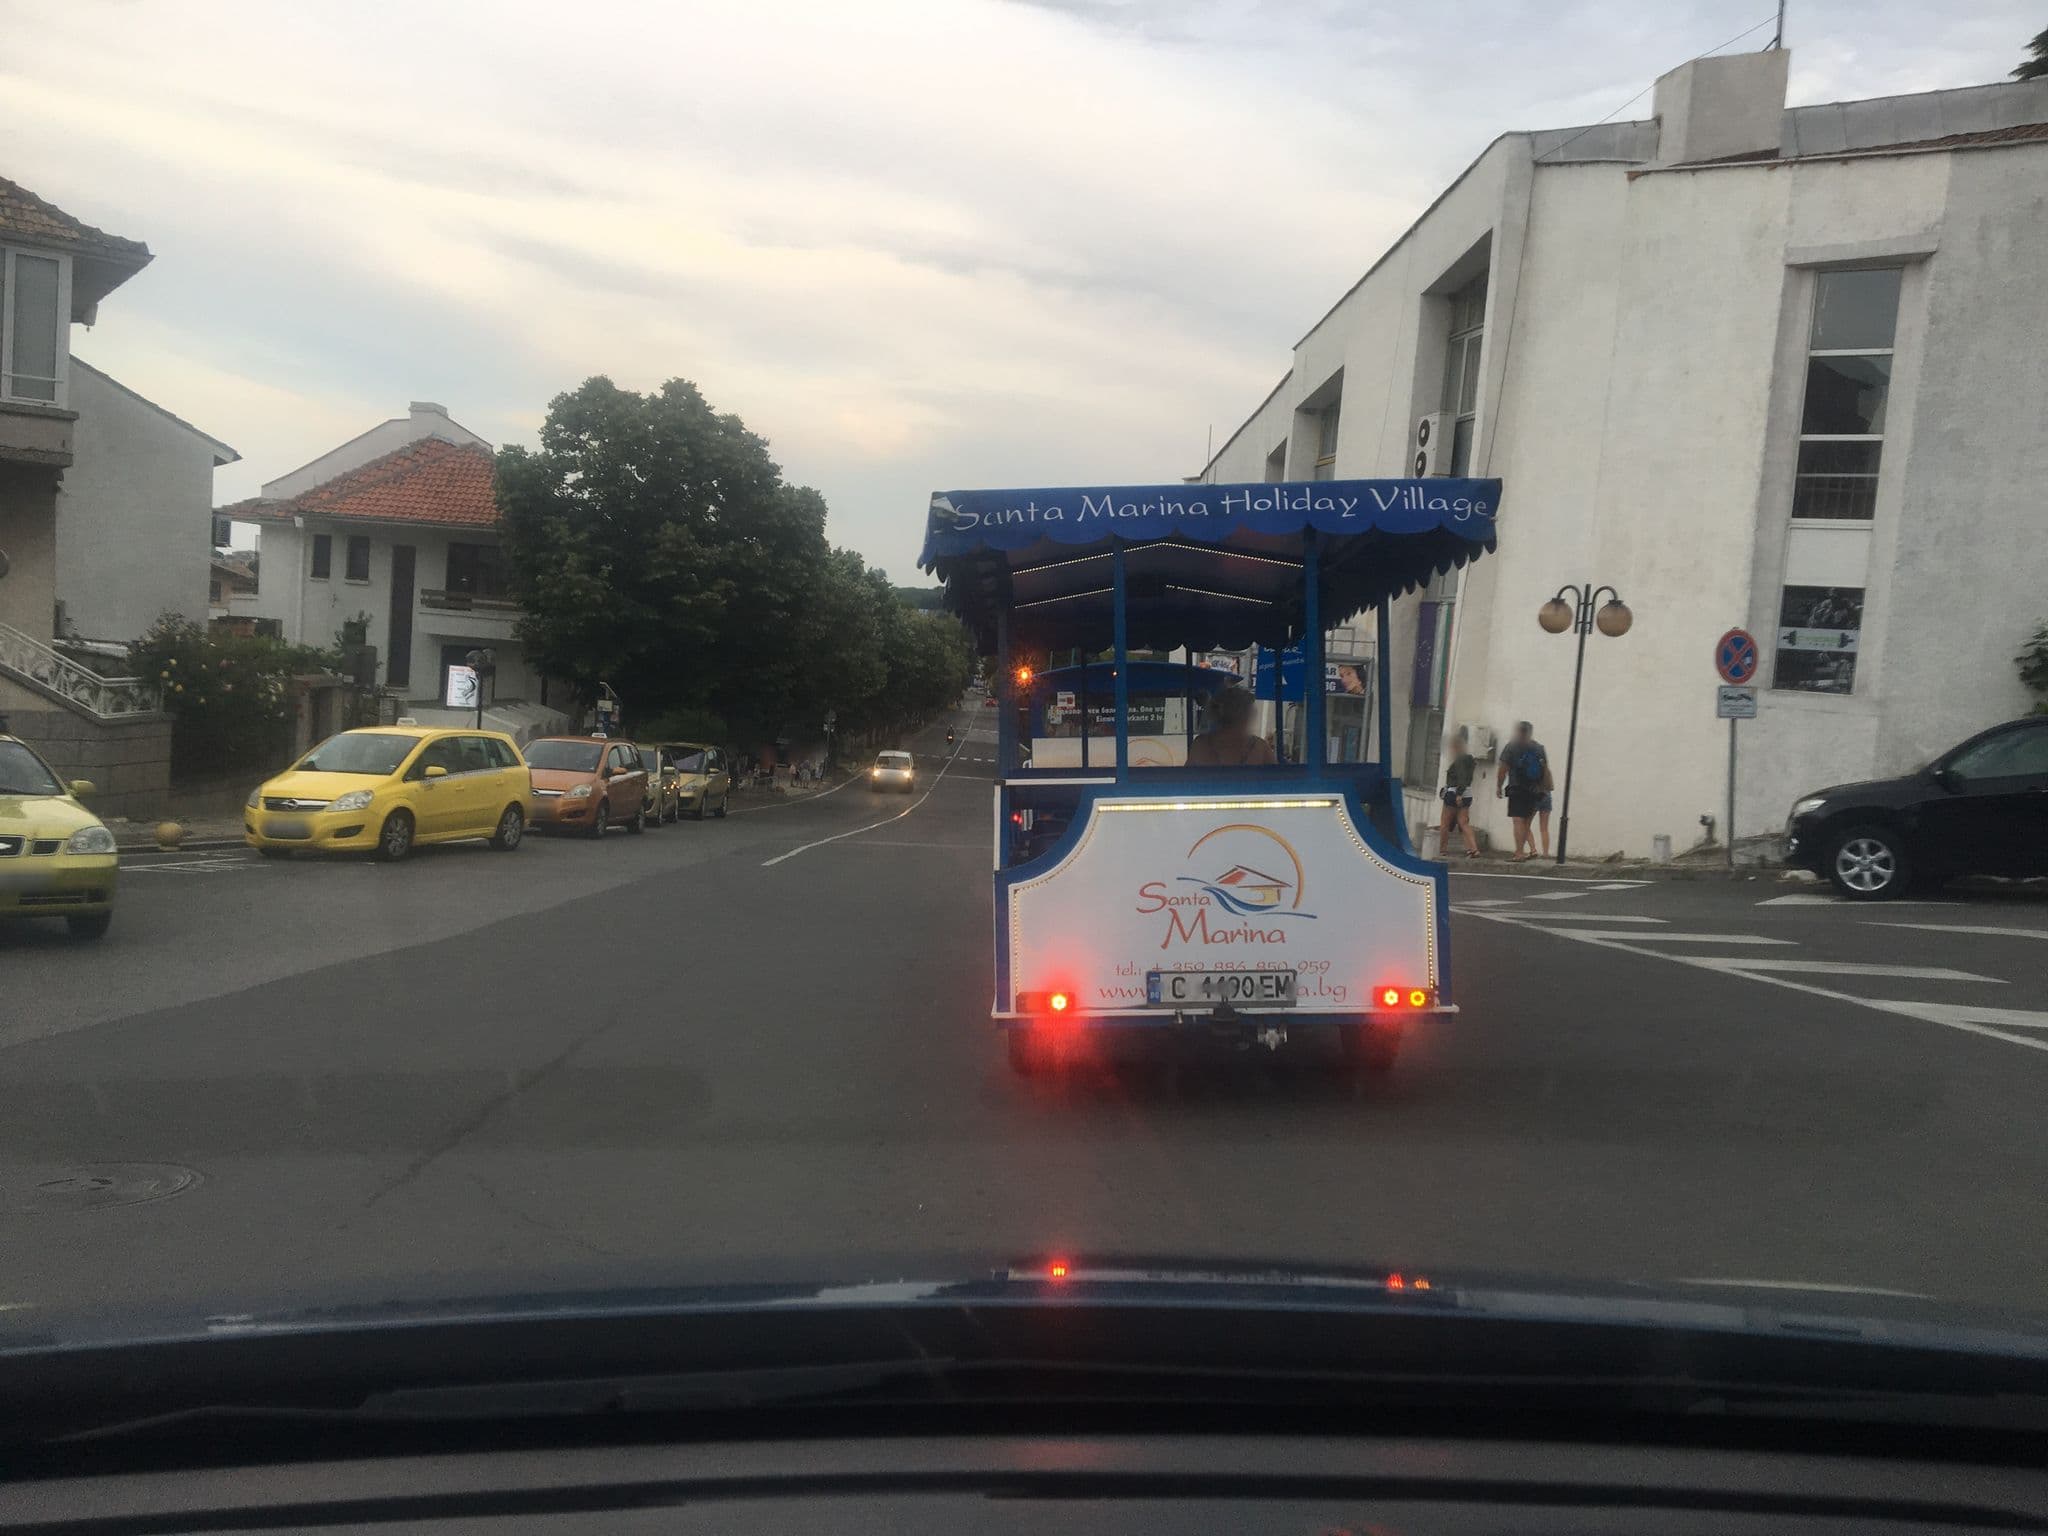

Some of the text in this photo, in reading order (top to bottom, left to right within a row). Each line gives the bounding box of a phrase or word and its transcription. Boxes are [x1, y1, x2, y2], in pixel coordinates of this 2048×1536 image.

[953, 486, 1488, 531] Santa Marina Holiday Village
[1136, 882, 1211, 913] Santa
[1161, 908, 1286, 949] Marina
[1297, 960, 1331, 974] 959
